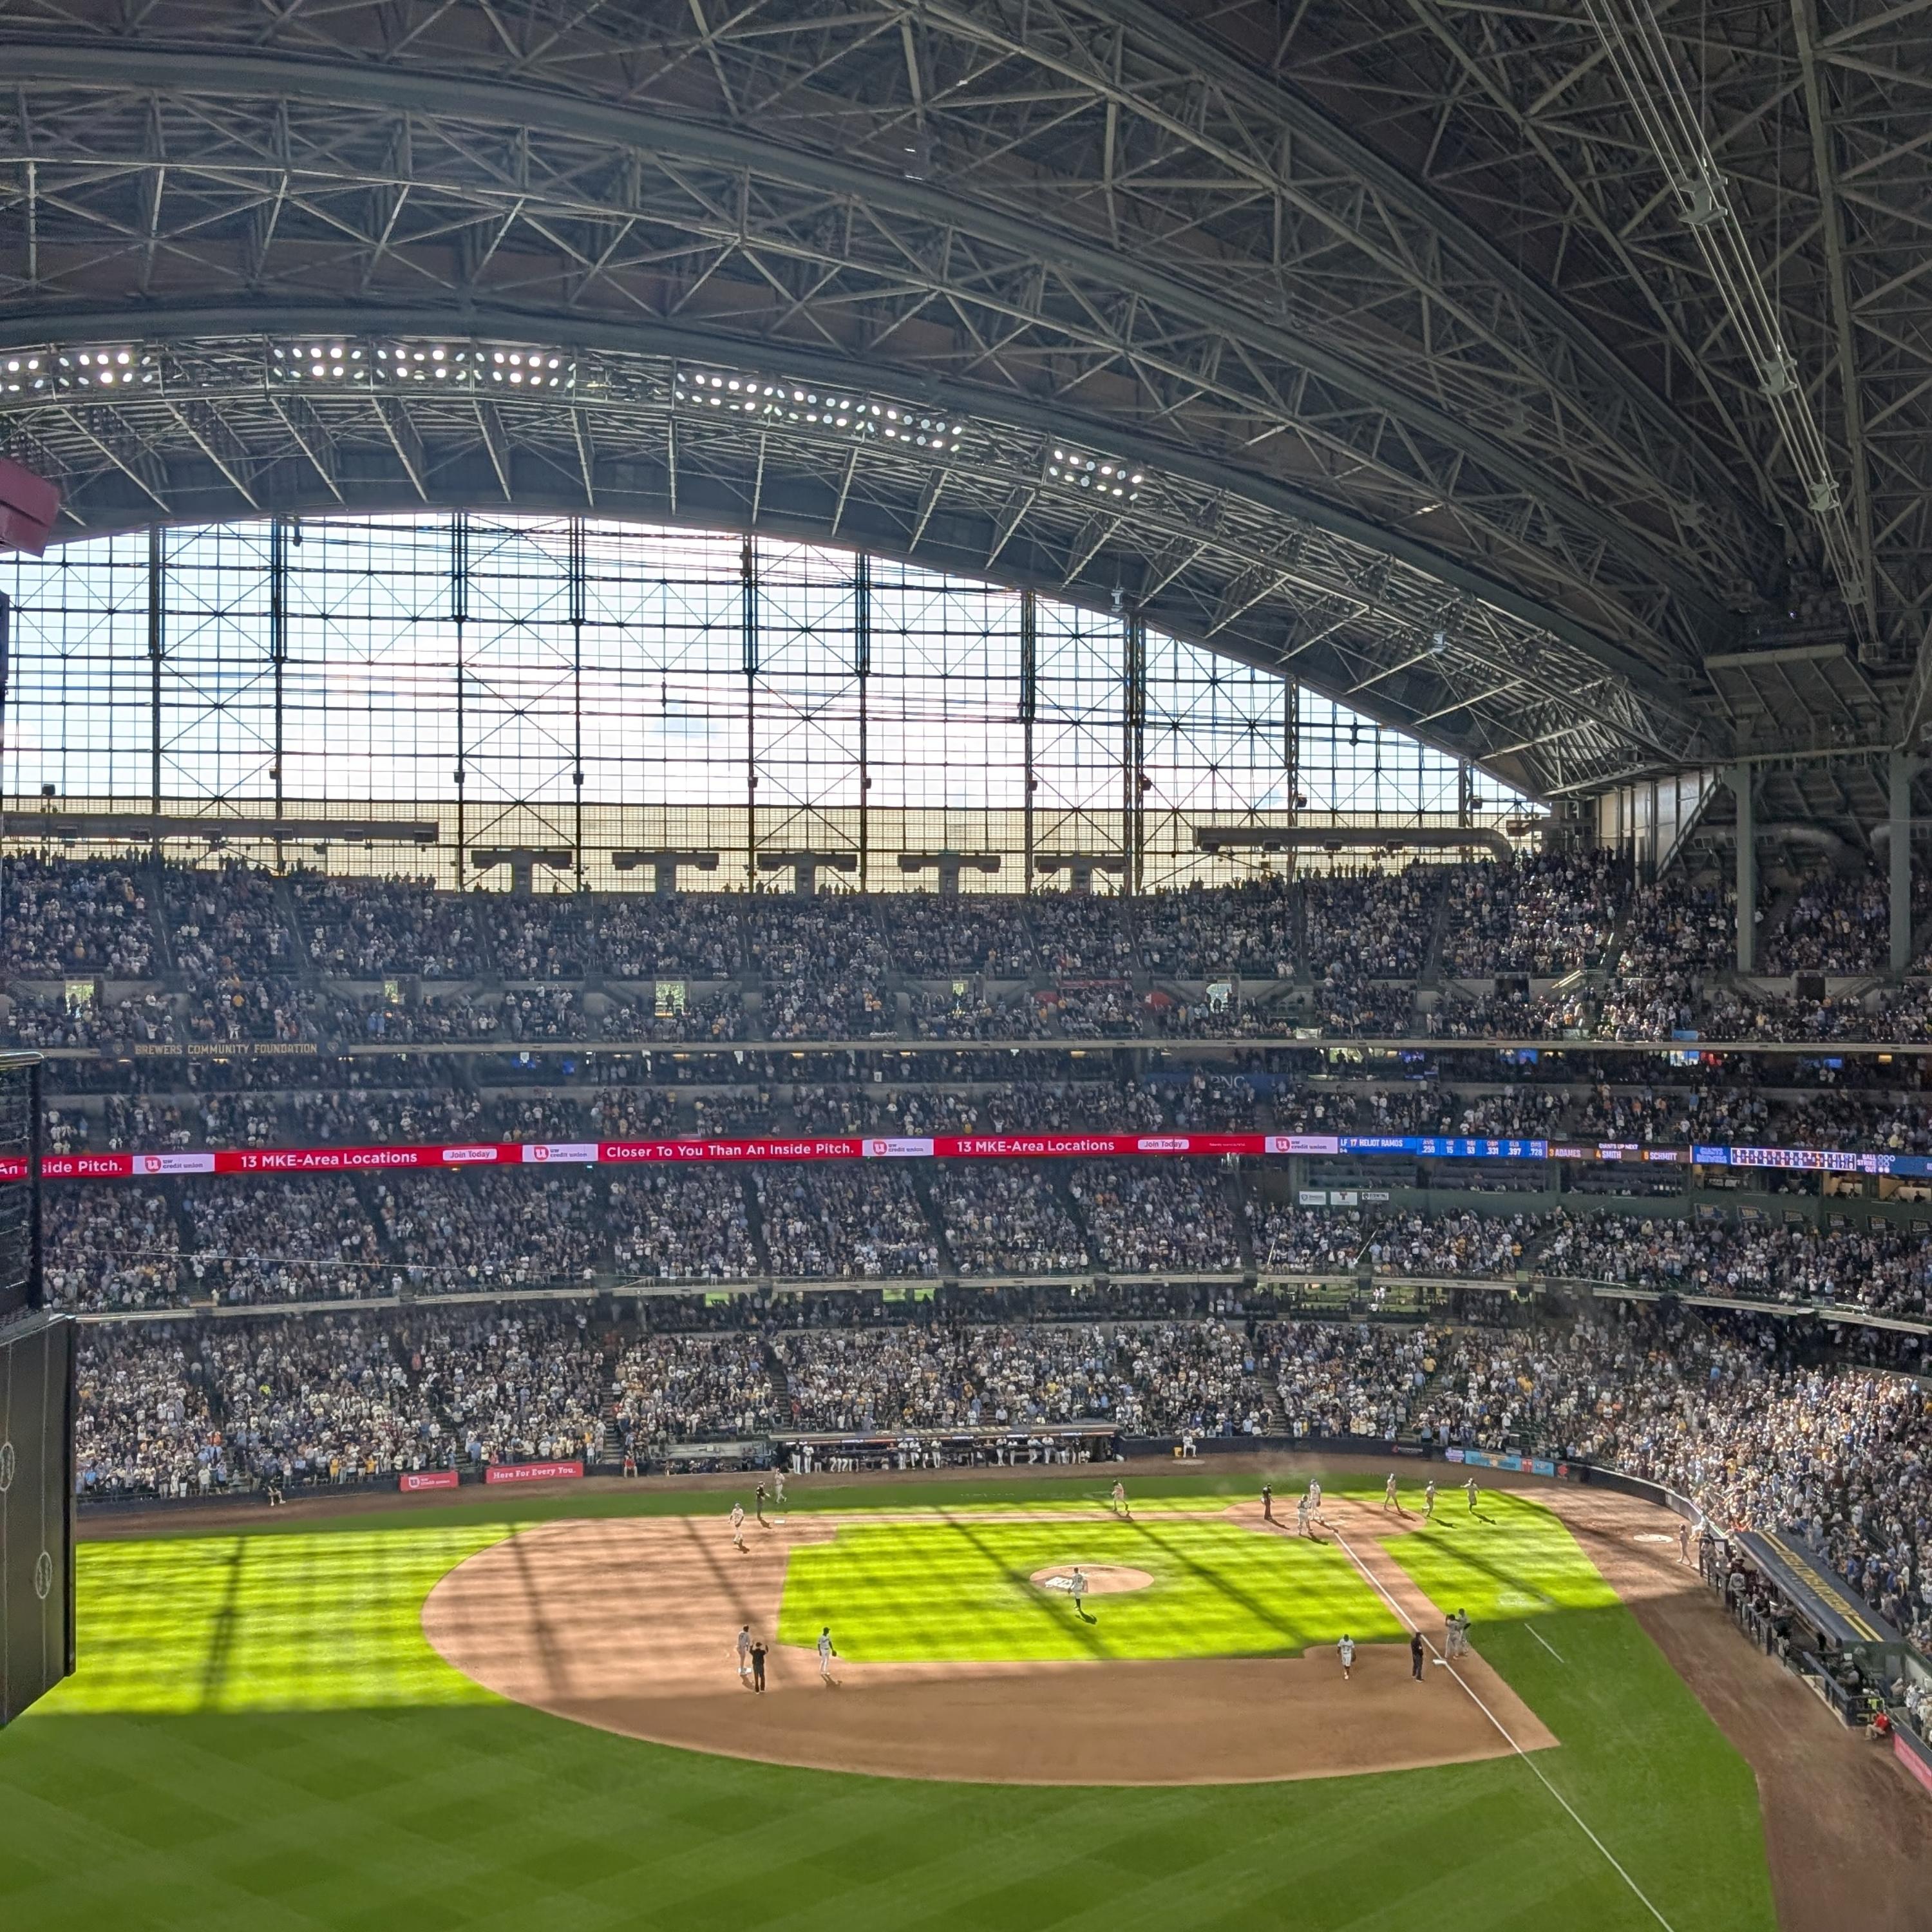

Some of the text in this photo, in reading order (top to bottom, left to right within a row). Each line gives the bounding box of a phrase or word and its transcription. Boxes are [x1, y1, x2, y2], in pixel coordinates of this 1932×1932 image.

[135, 1043, 317, 1055] BREWERS COMMUNITY FOUNDATION
[607, 1142, 855, 1157] Closer To You Than An Inside Pitch.
[958, 1139, 1115, 1152] 13 MKE-Area Locations
[1161, 1141, 1183, 1149] Today
[469, 1150, 490, 1159] Today
[1555, 1149, 1581, 1157] ADAMES
[1602, 1151, 1622, 1159] SMITH
[242, 1151, 417, 1168] 13 MKE-Area Locations
[78, 1159, 122, 1172] Pitch.
[532, 1468, 555, 1476] Every
